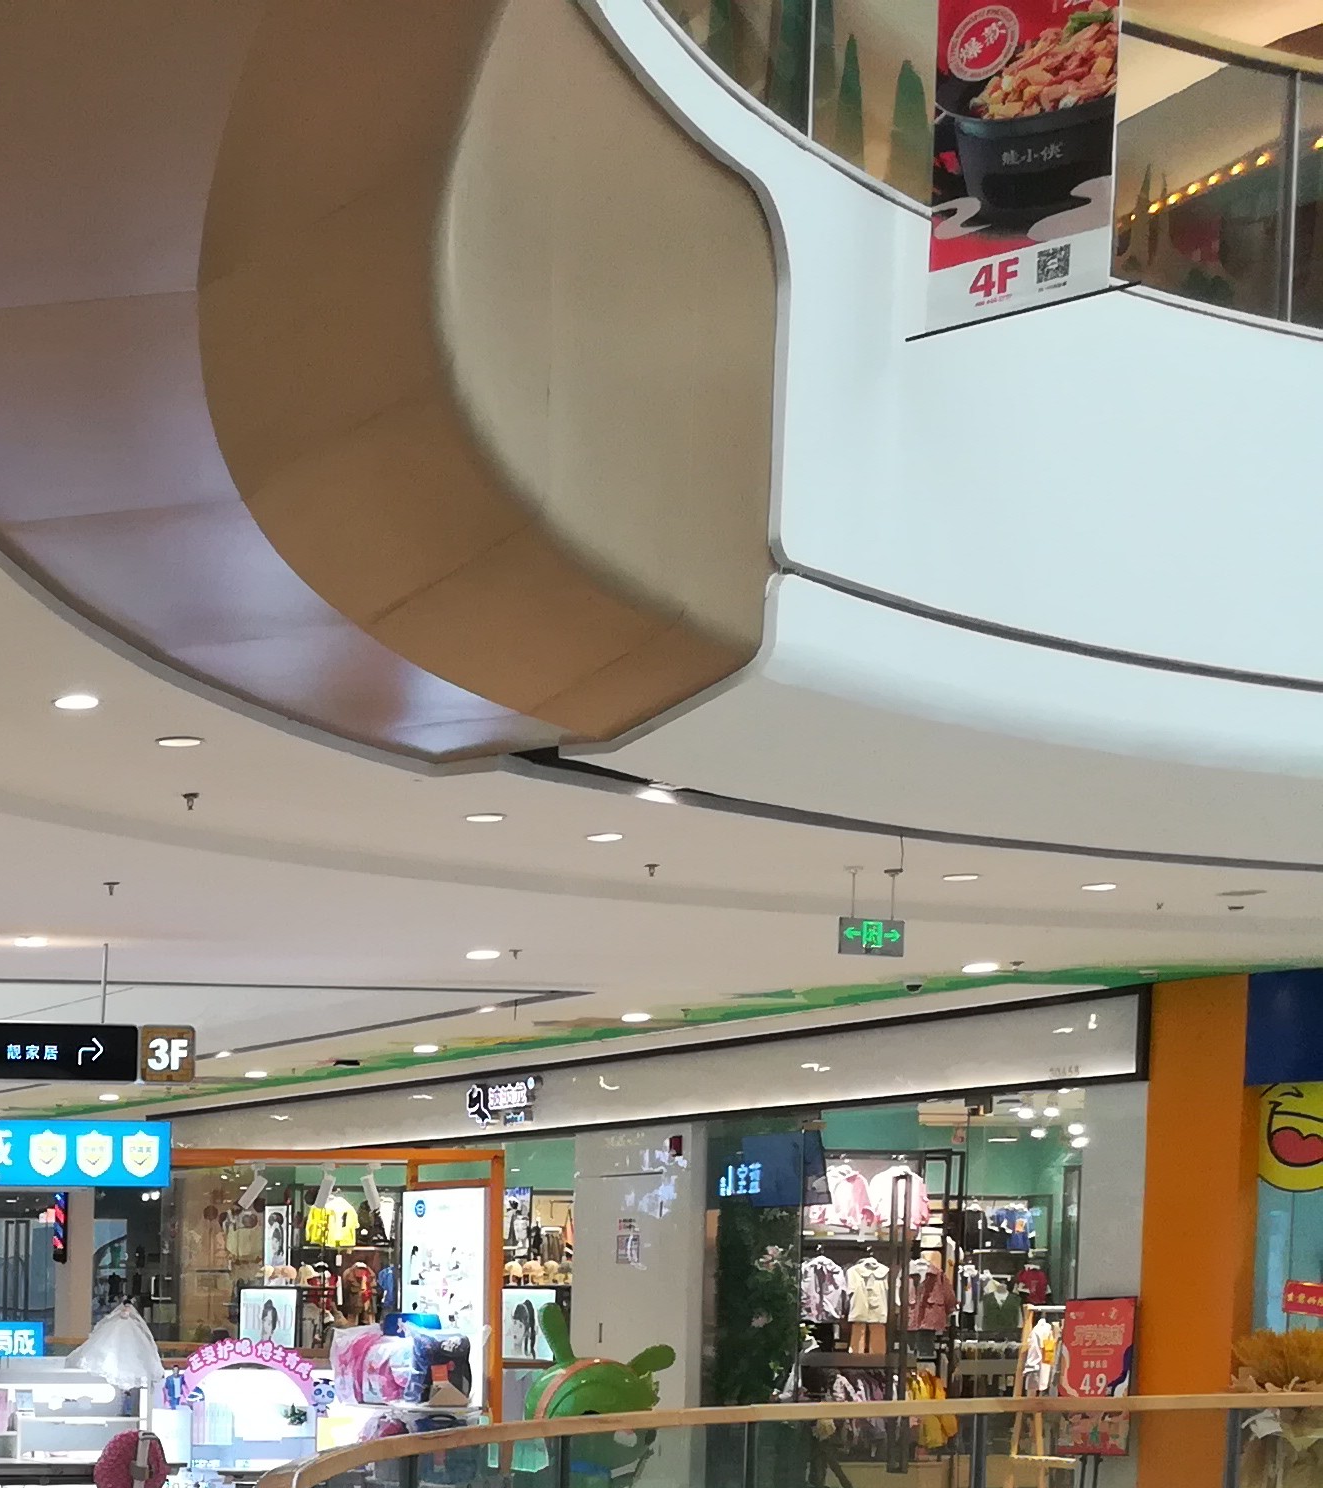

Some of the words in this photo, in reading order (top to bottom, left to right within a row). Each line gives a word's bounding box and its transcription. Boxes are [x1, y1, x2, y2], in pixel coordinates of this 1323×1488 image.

[969, 256, 1020, 298] 4F
[6, 1043, 59, 1060] 靓家居
[147, 1038, 189, 1072] 3F
[1079, 1373, 1107, 1395] 4.9
